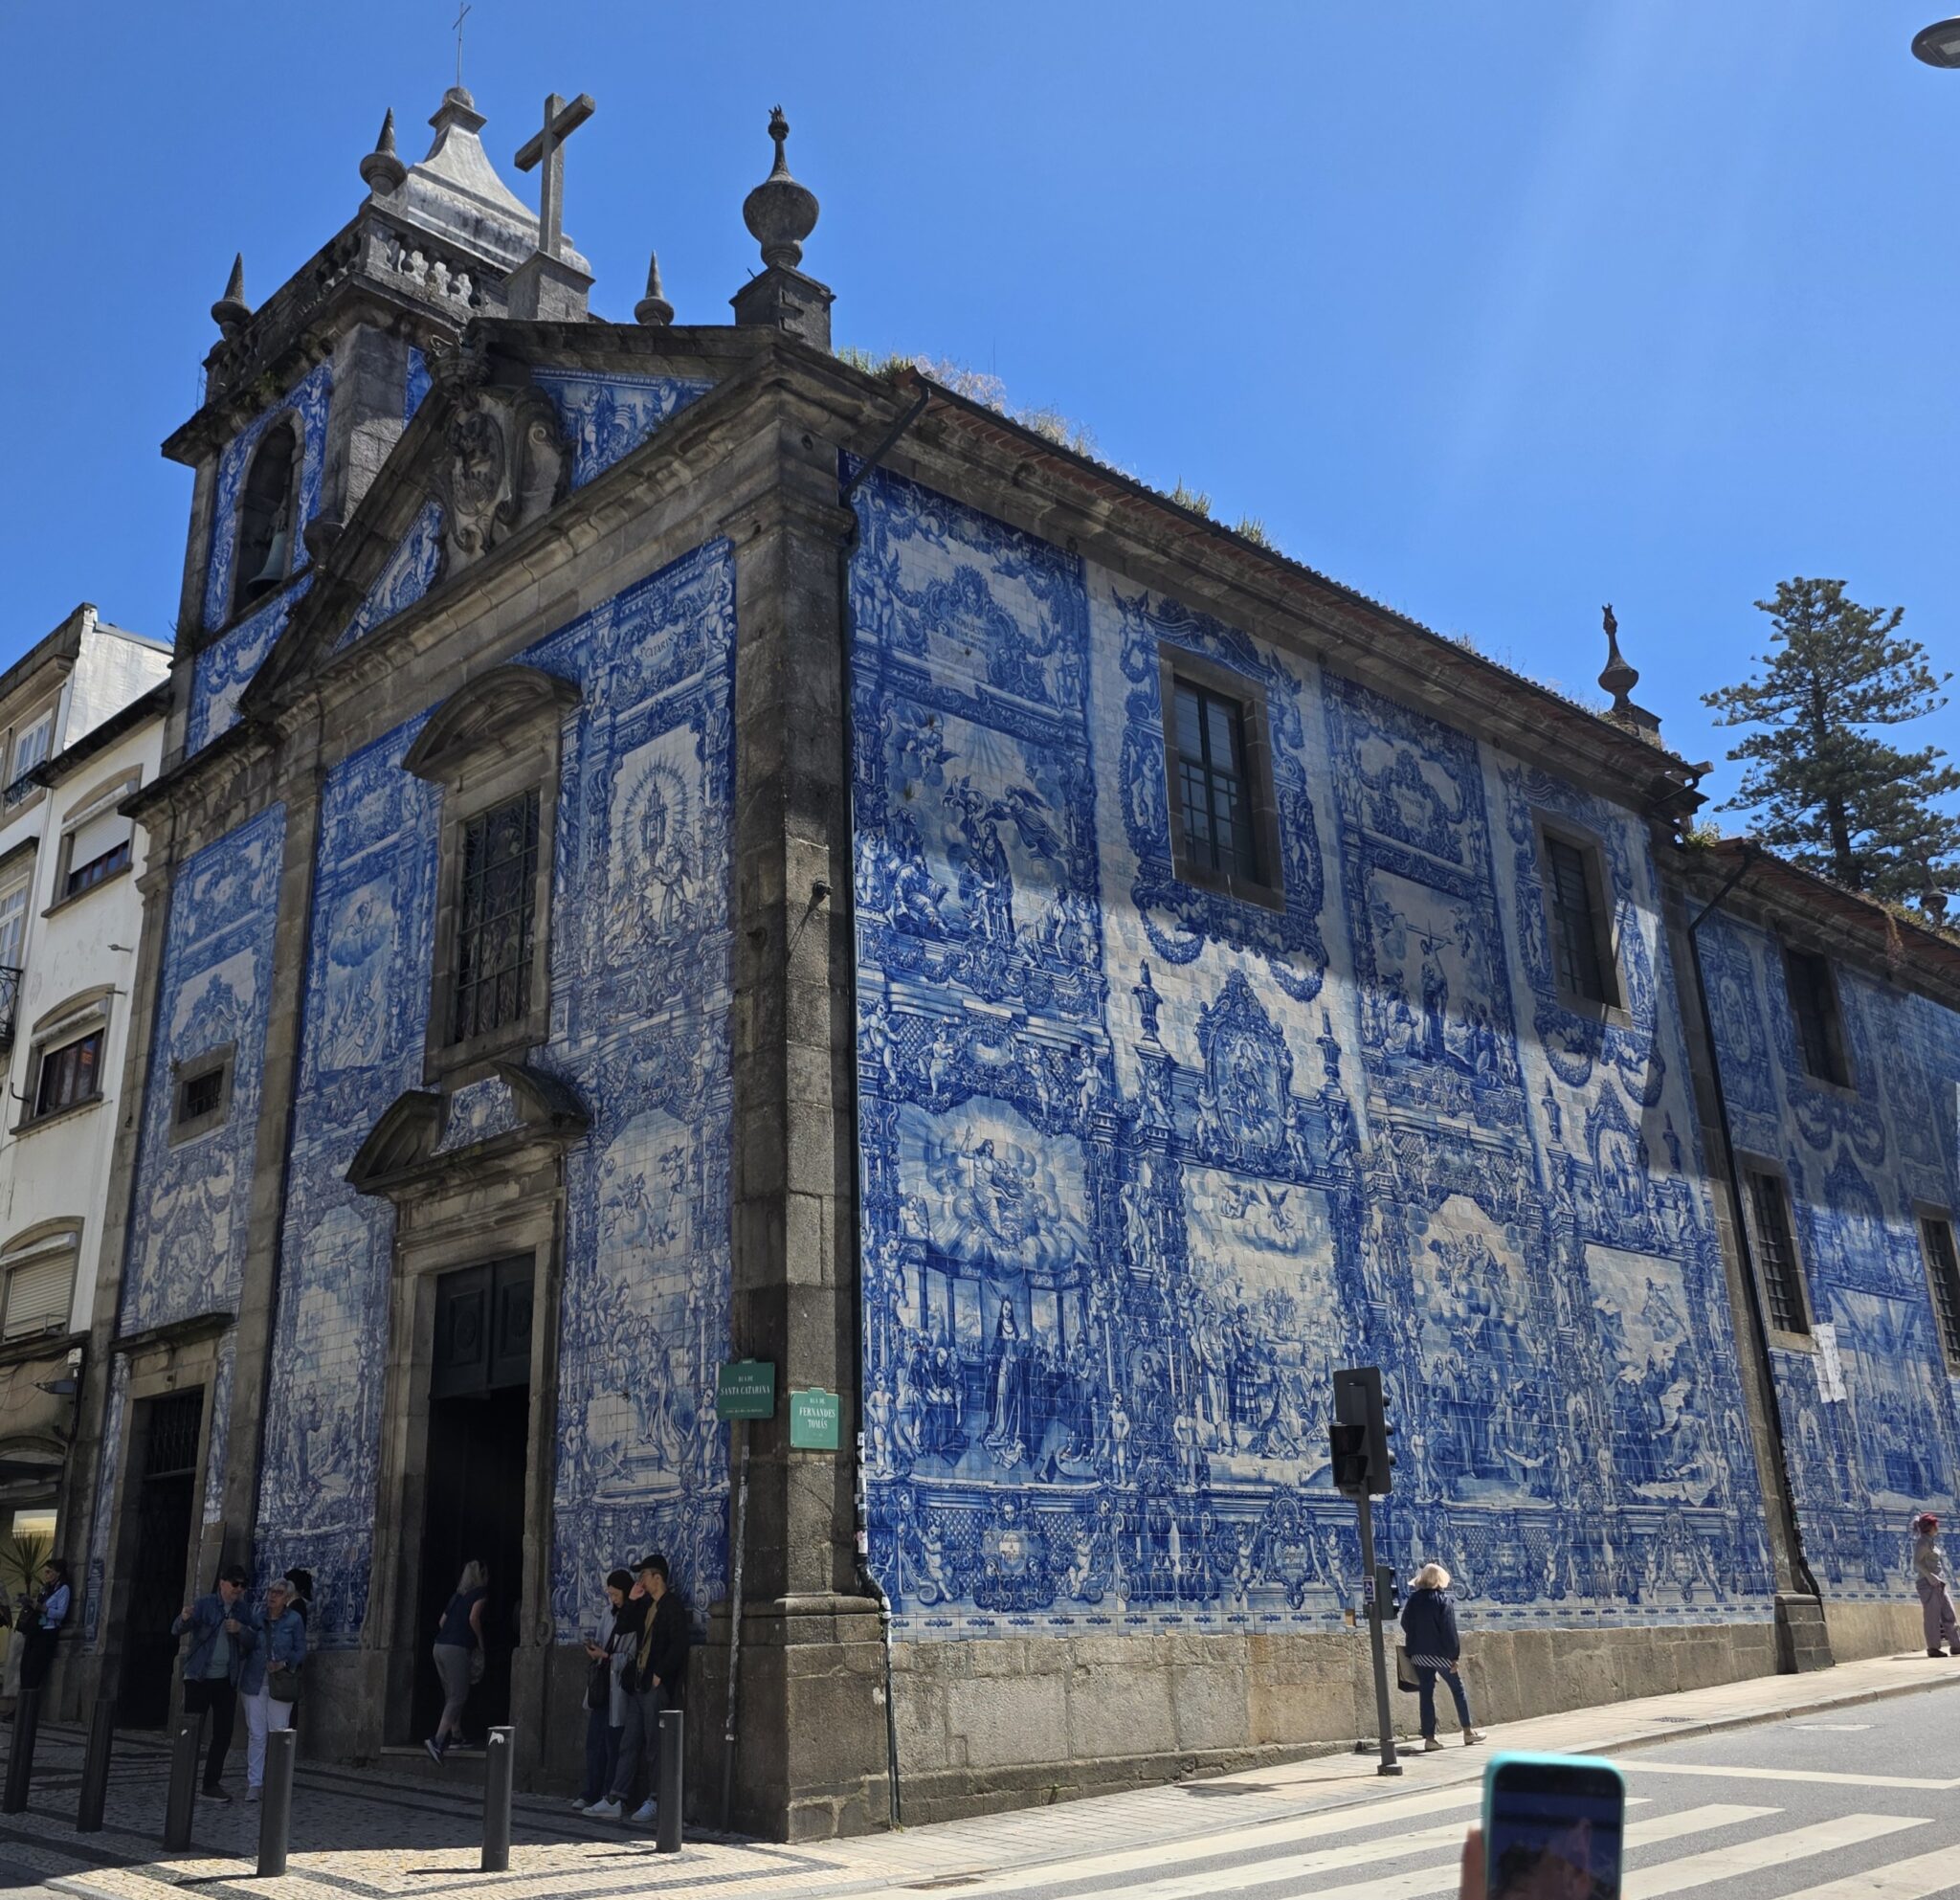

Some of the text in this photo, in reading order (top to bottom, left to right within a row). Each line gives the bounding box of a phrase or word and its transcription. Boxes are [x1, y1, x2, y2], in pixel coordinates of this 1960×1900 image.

[720, 1385, 770, 1396] SANTA CATARINA
[799, 1407, 835, 1419] FERNANDES
[807, 1418, 828, 1429] TOMÁS
